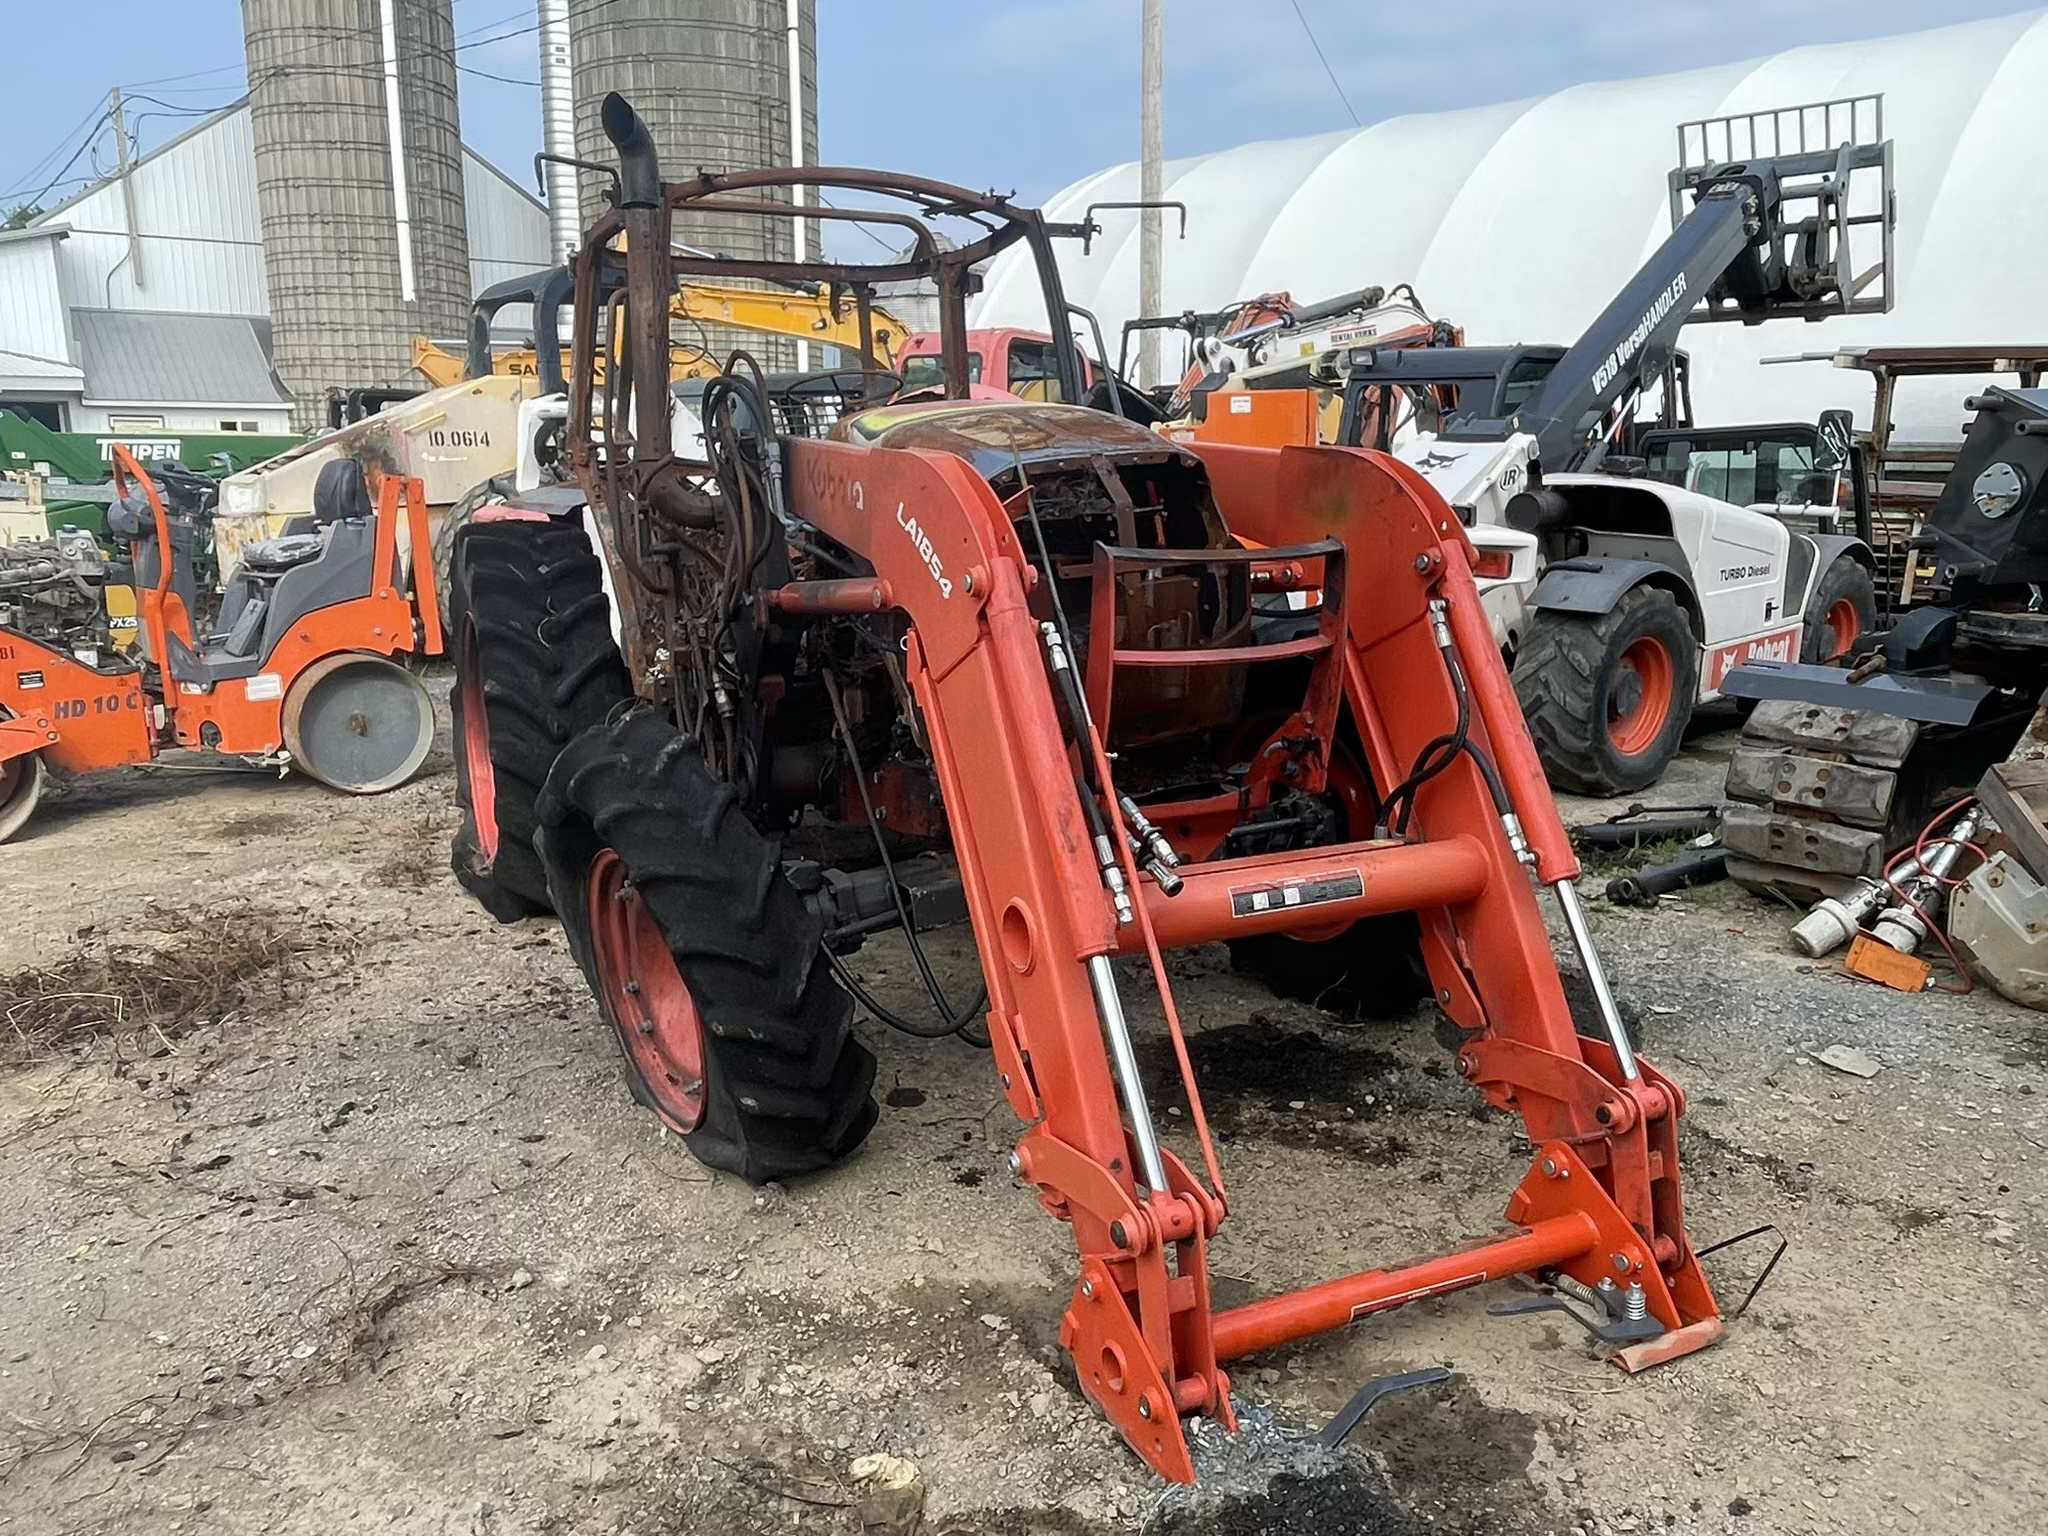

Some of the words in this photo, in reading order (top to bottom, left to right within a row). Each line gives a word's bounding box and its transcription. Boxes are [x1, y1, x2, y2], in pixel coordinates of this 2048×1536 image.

[1592, 353, 1618, 395] V518
[1616, 272, 1687, 367] VersaHANDLER
[95, 439, 181, 461] TPEN
[428, 431, 490, 447] 10.0614
[896, 501, 953, 600] LA1854
[1720, 566, 1747, 581] TURBO
[1748, 563, 1771, 578] Diesel
[1747, 635, 1791, 663] Bobcat
[54, 699, 87, 720] HD
[93, 695, 119, 713] 10
[125, 692, 138, 710] C
